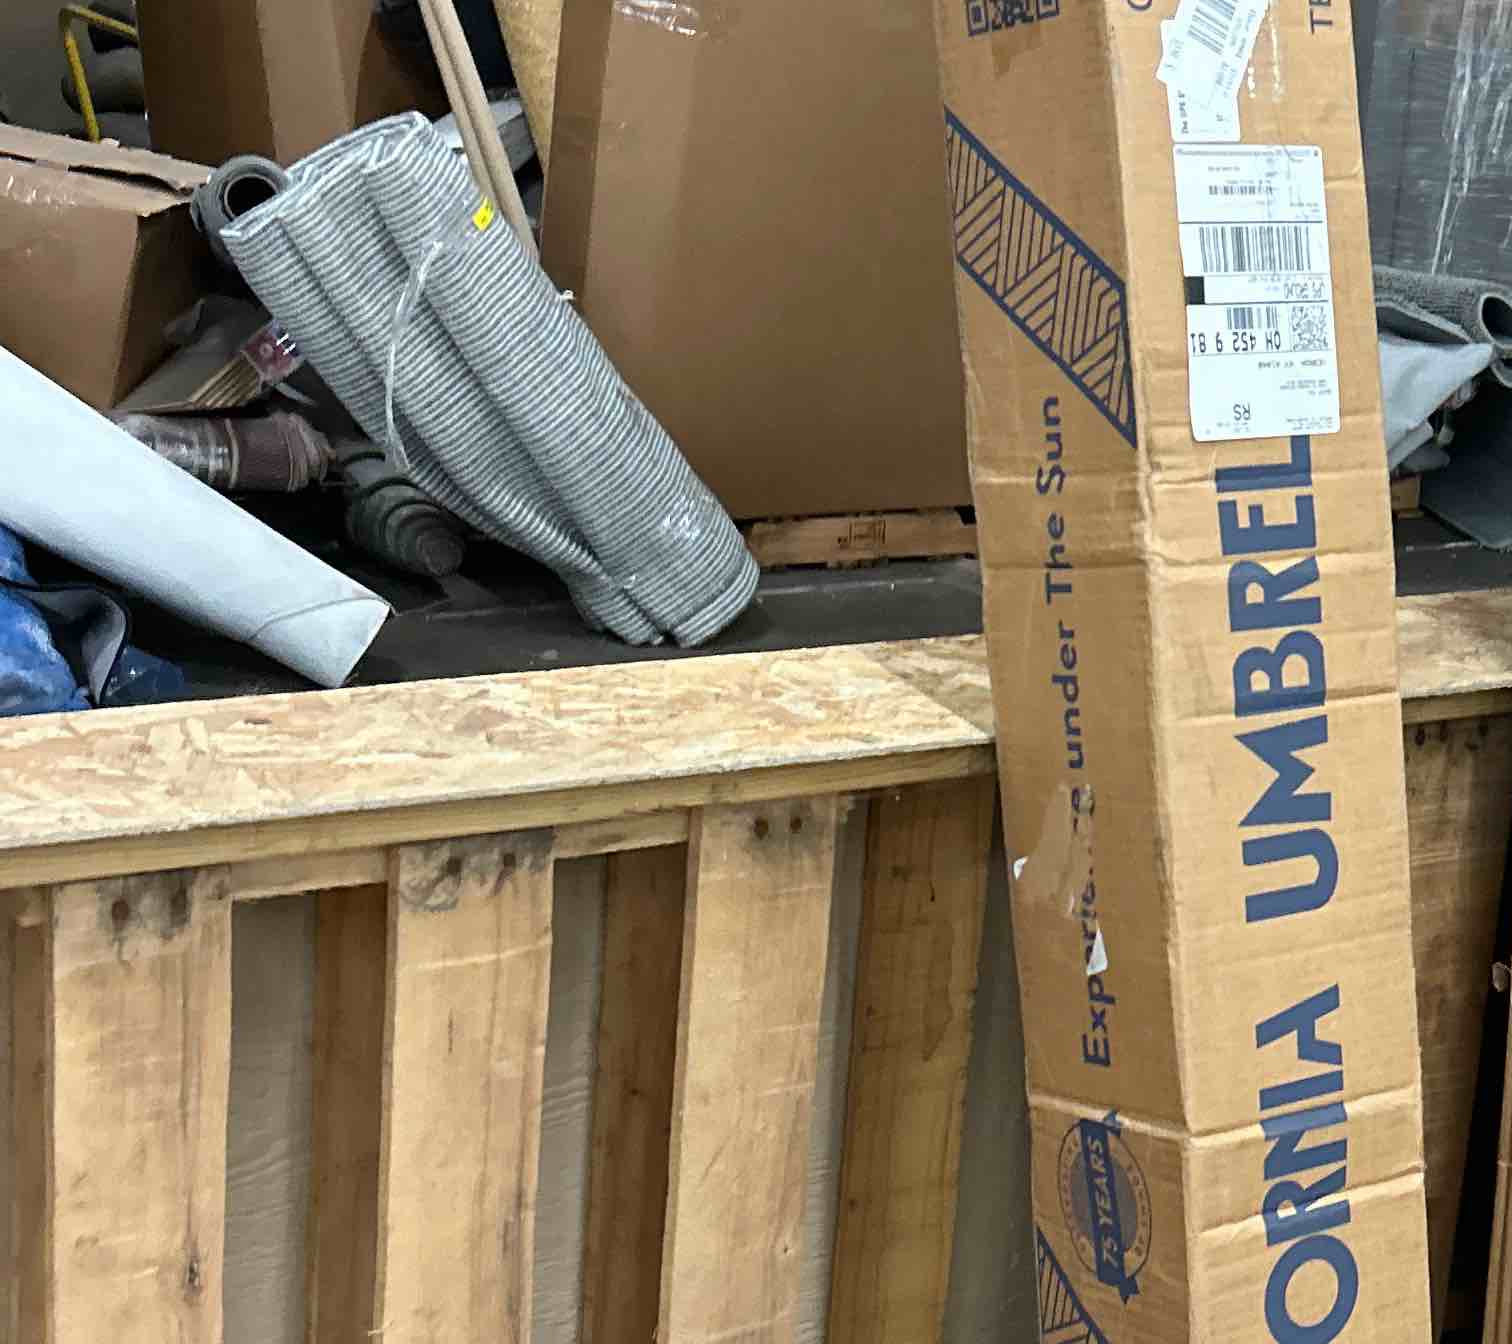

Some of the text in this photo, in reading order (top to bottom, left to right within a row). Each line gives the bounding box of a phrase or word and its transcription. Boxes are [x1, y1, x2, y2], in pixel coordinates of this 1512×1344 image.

[1189, 330, 1281, 353] OH 452 9 81
[1035, 396, 1067, 498] Sun
[1233, 403, 1252, 421] RS
[1043, 512, 1075, 605] The
[1052, 621, 1087, 769] under
[1213, 434, 1340, 923] UMBREL
[1086, 1135, 1113, 1226] YEARS
